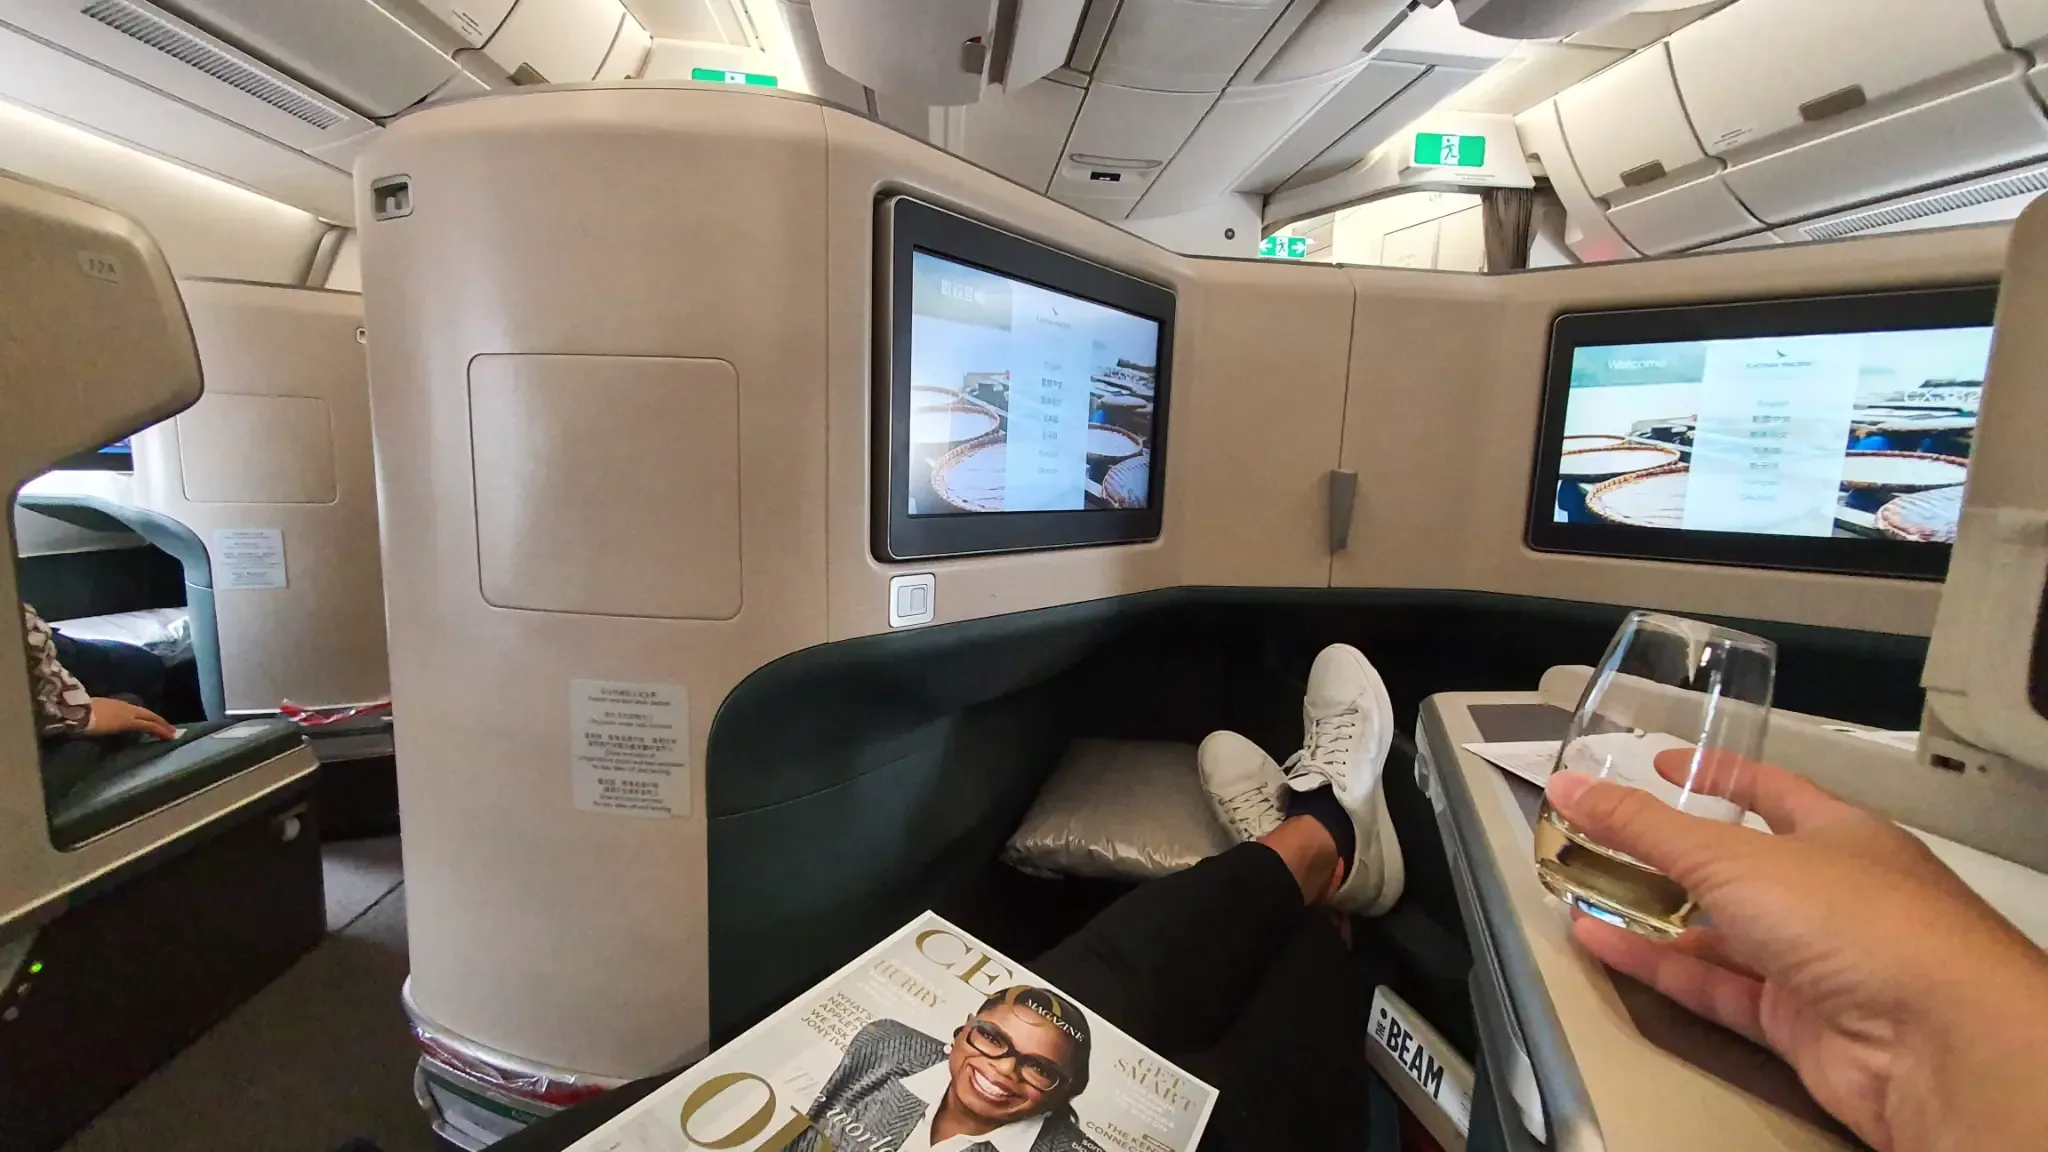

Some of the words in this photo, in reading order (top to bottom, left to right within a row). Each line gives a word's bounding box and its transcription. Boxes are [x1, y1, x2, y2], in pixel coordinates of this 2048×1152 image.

[1607, 359, 1667, 370] Welcome
[915, 929, 1062, 1028] CEO
[819, 1003, 859, 1032] APPLE?
[828, 996, 857, 1018] NEXT
[1025, 998, 1085, 1042] MAGAZINE
[801, 1016, 832, 1038] JONY
[811, 1008, 831, 1025] WE
[828, 1024, 851, 1041] ASK
[1375, 1020, 1386, 1040] THE
[1386, 1017, 1444, 1100] BEAM
[1114, 1058, 1196, 1111] SMART
[1086, 1121, 1146, 1152] CONNEC
[1107, 1122, 1131, 1140] THE
